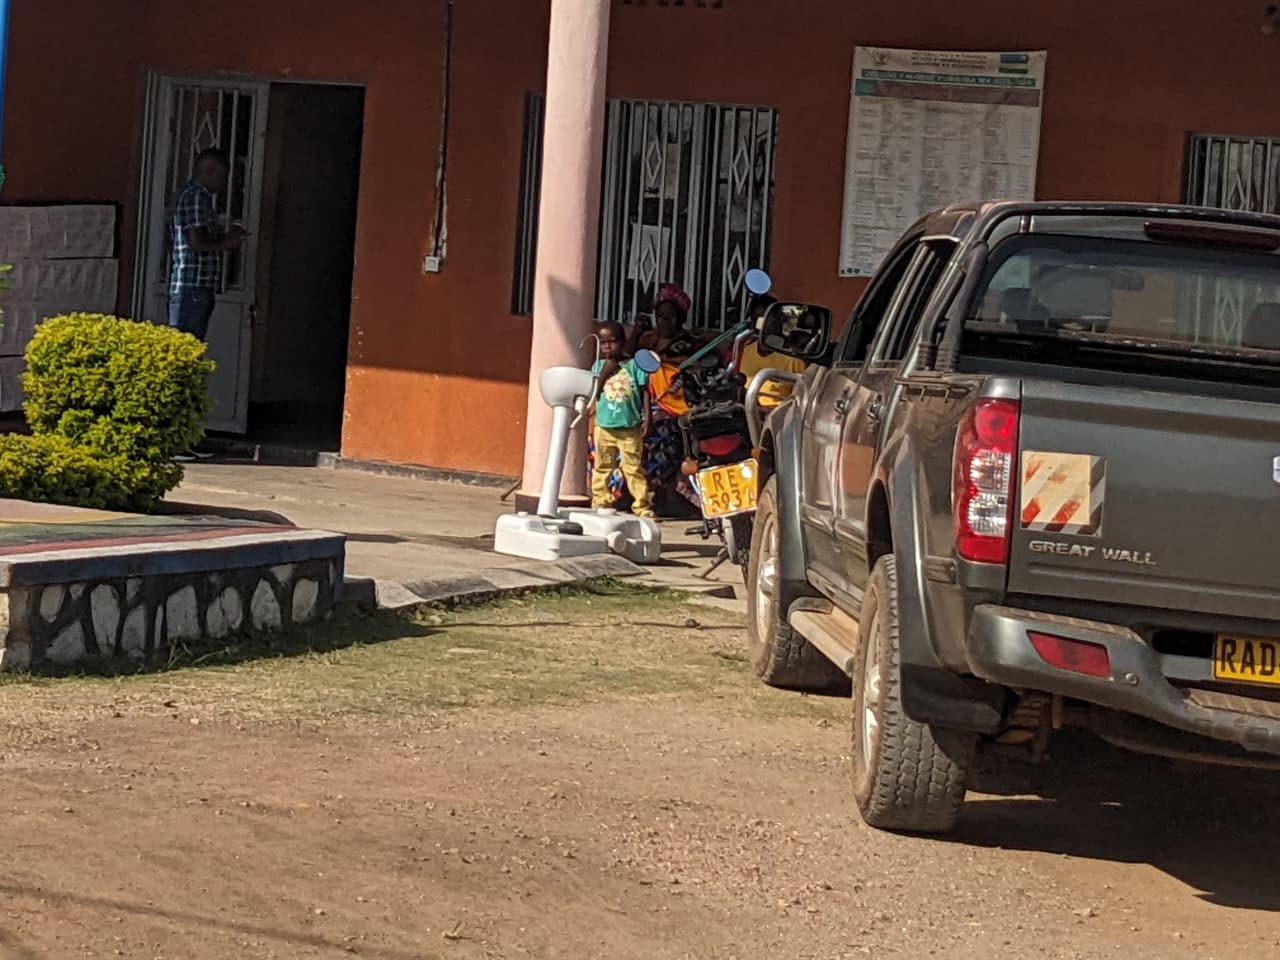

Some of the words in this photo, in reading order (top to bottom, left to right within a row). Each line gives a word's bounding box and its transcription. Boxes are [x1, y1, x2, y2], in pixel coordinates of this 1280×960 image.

[712, 469, 739, 492] RE
[1029, 540, 1096, 558] GREAT
[1102, 548, 1157, 565] WALL
